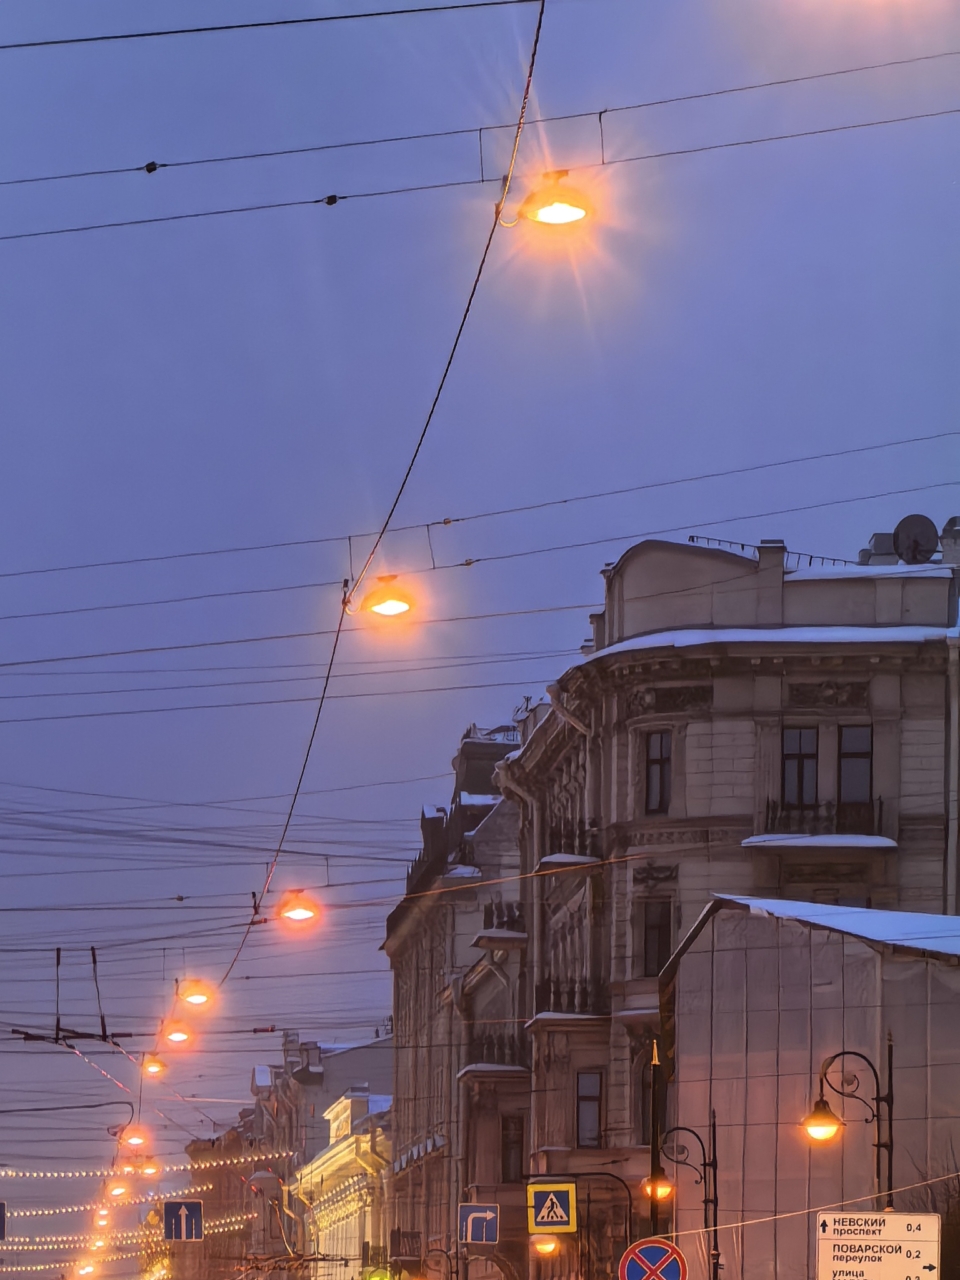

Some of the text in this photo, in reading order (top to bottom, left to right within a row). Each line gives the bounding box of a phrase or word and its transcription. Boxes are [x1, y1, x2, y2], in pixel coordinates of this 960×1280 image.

[833, 1217, 922, 1232] НЕВСКИЙ 0,4
[833, 1228, 882, 1237] проспект
[832, 1243, 921, 1259] ПОВАРСКОЙ 0,2
[832, 1254, 882, 1263] переулок
[832, 1269, 864, 1278] улица
